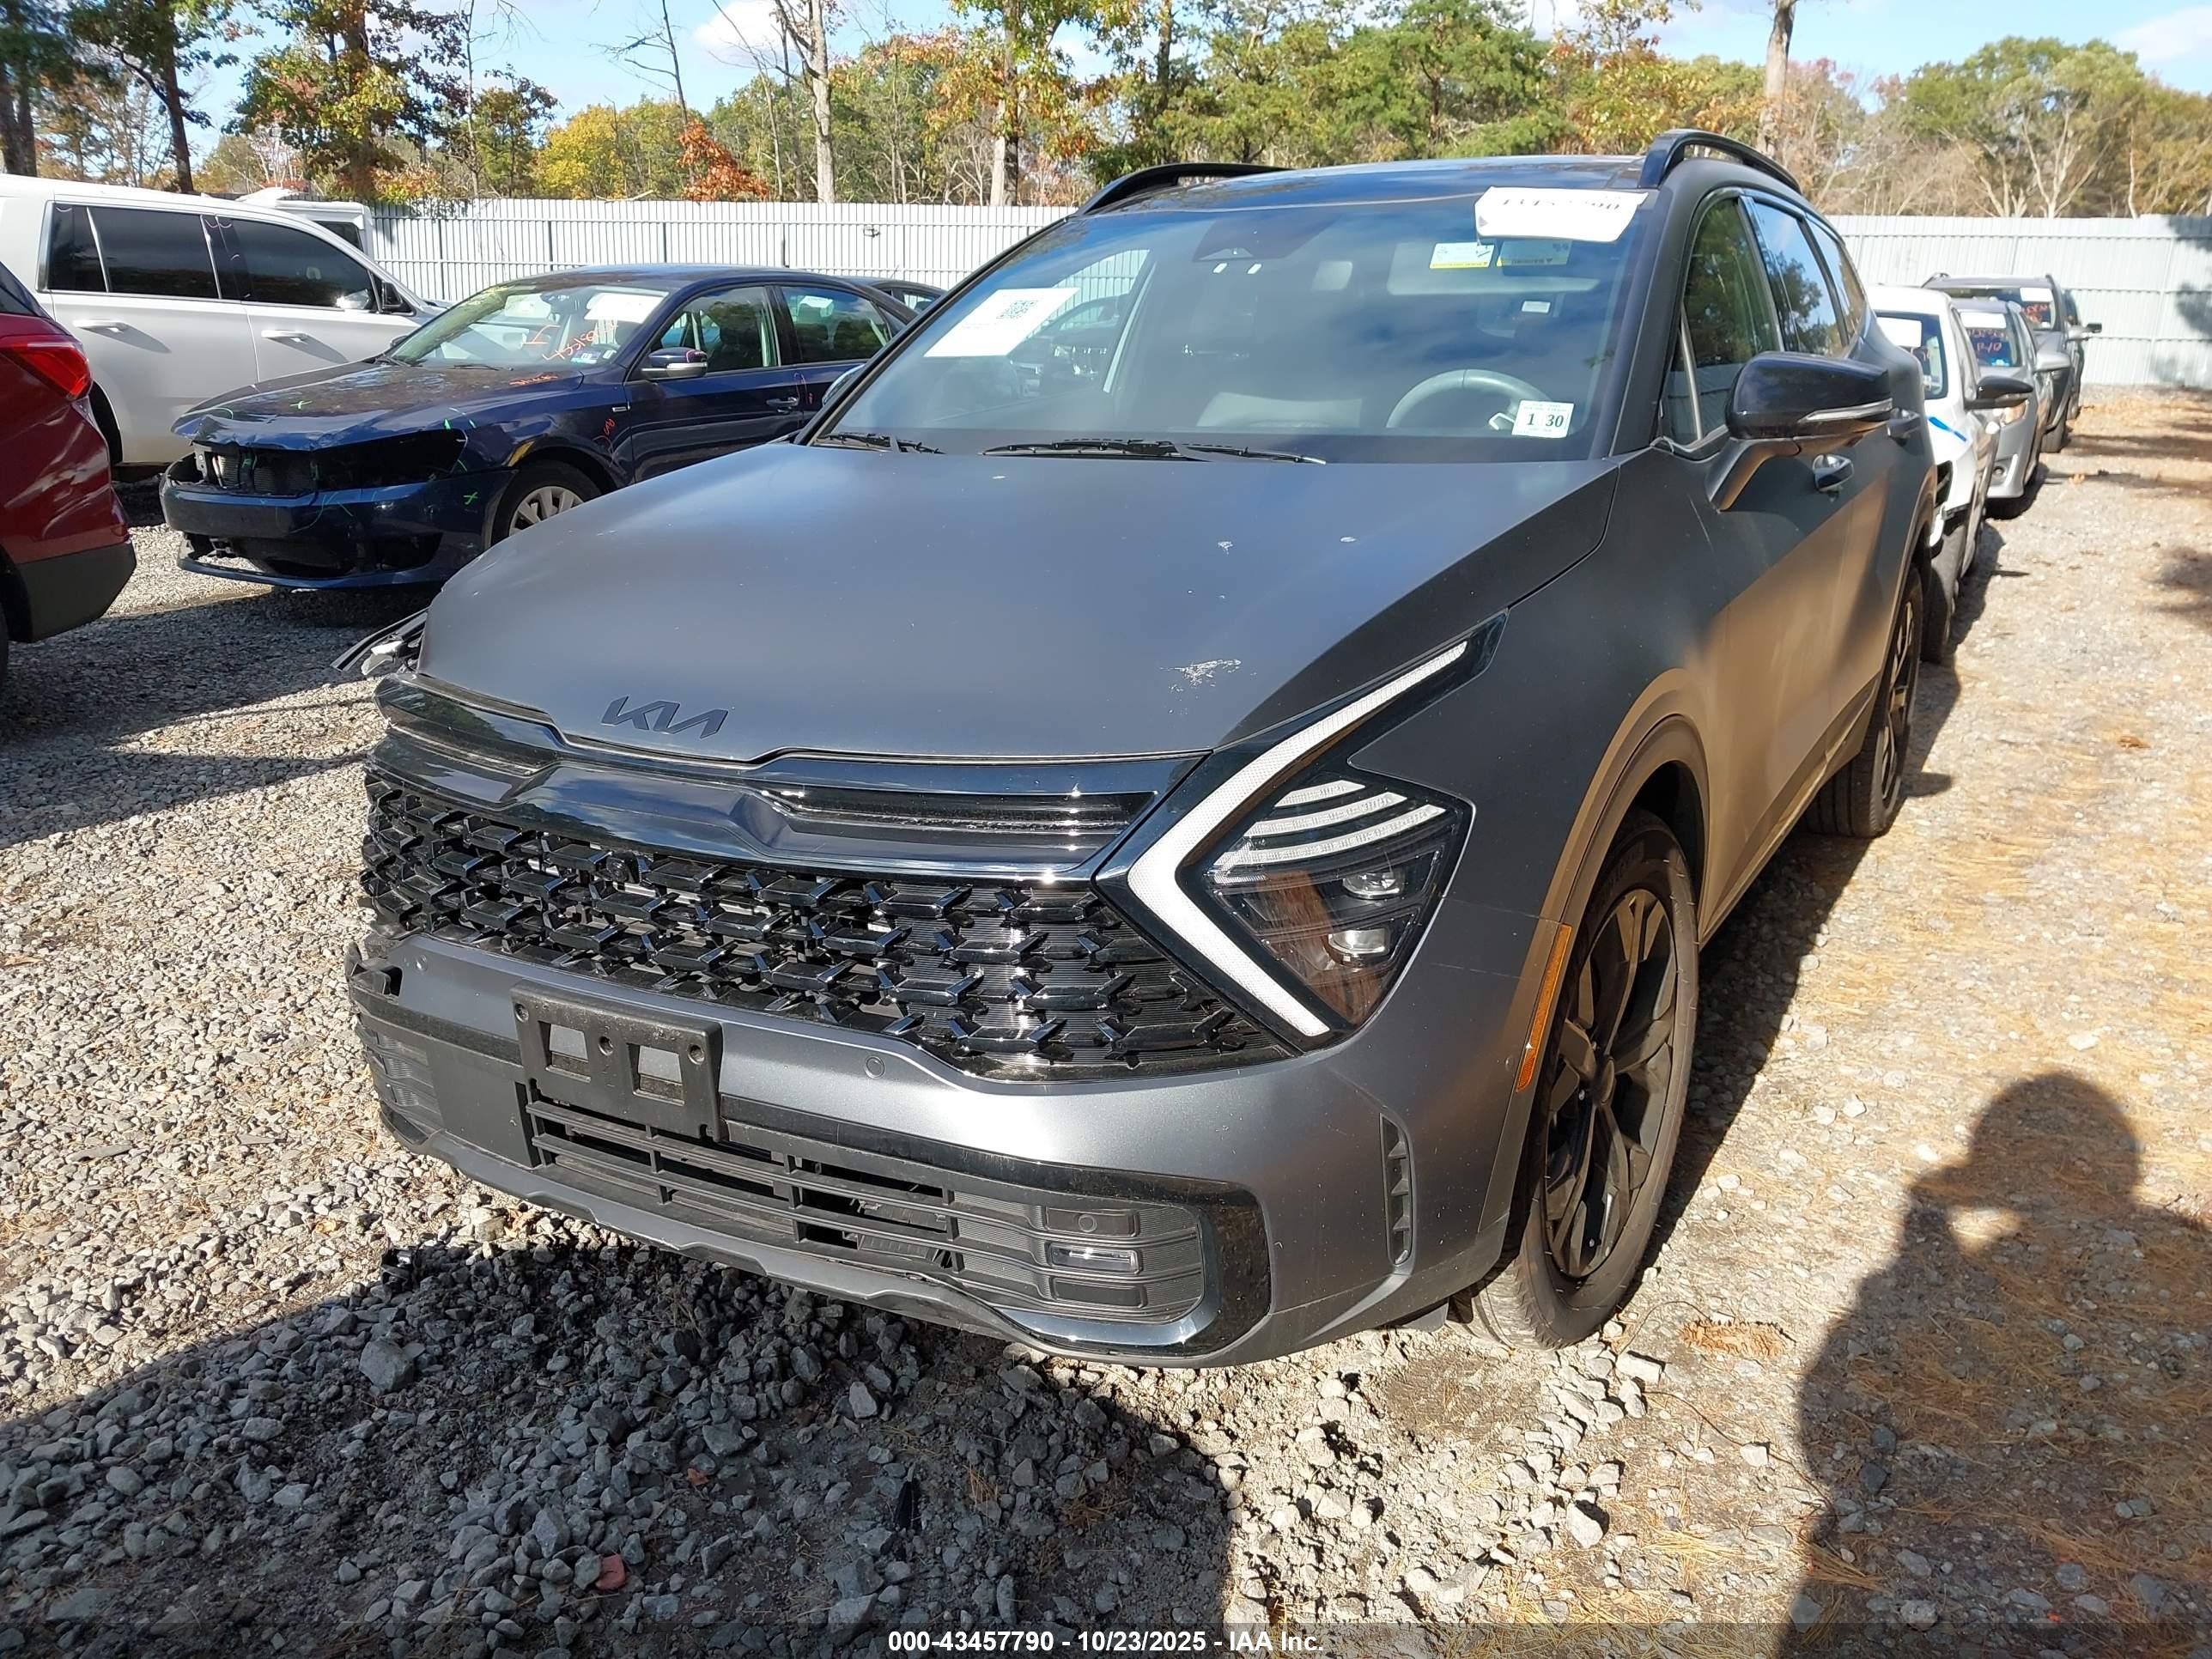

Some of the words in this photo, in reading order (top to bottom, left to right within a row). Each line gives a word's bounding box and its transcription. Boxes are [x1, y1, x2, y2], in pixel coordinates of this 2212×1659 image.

[1526, 413, 1534, 425] 1
[1545, 414, 1565, 428] 30
[600, 695, 729, 739] KIA
